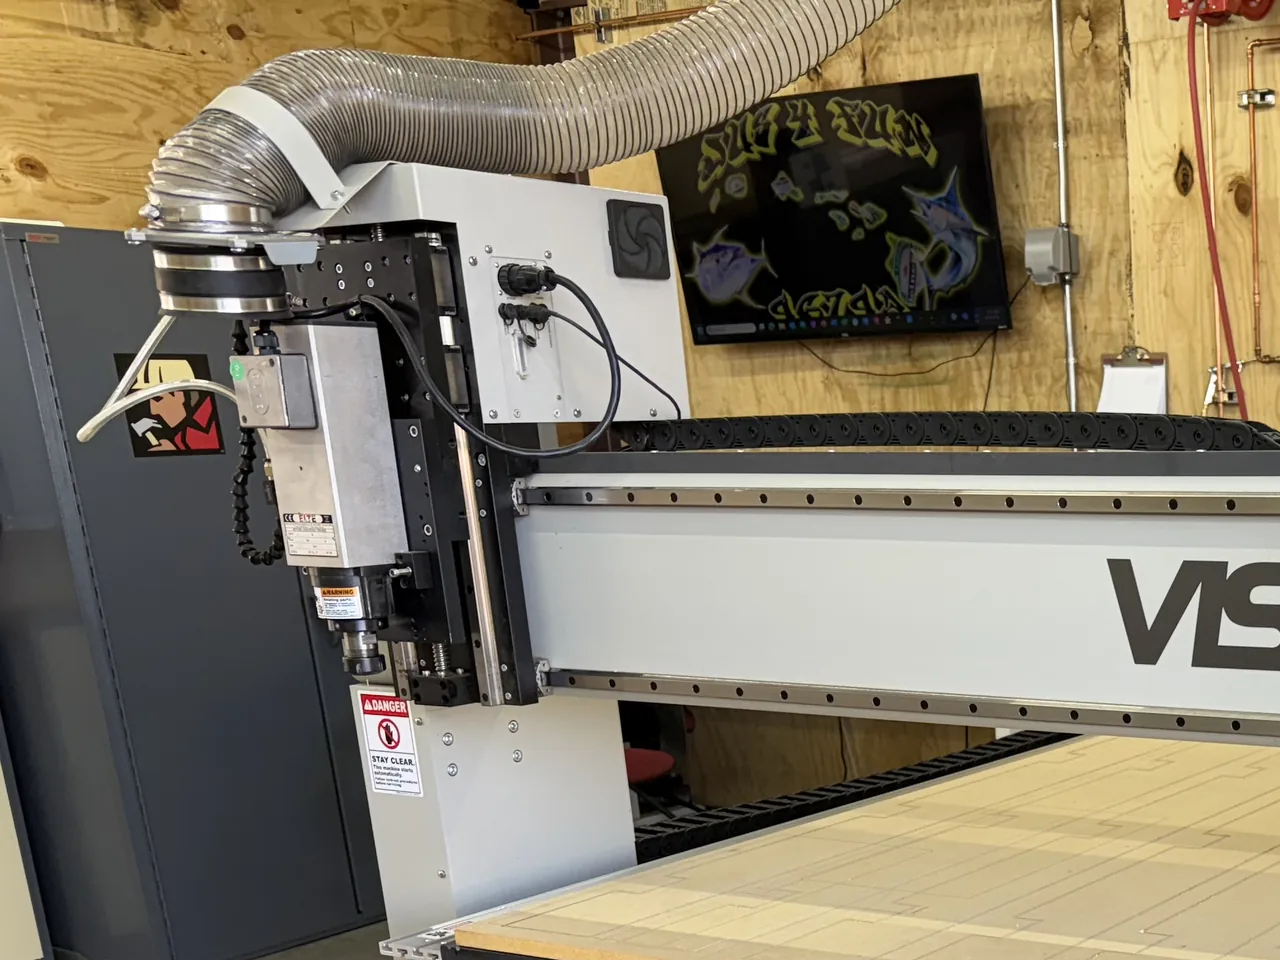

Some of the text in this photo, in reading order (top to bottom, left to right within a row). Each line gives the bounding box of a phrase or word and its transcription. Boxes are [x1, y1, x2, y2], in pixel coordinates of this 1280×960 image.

[372, 699, 407, 713] DANGER
[371, 755, 415, 767] STAY CLEAR.
